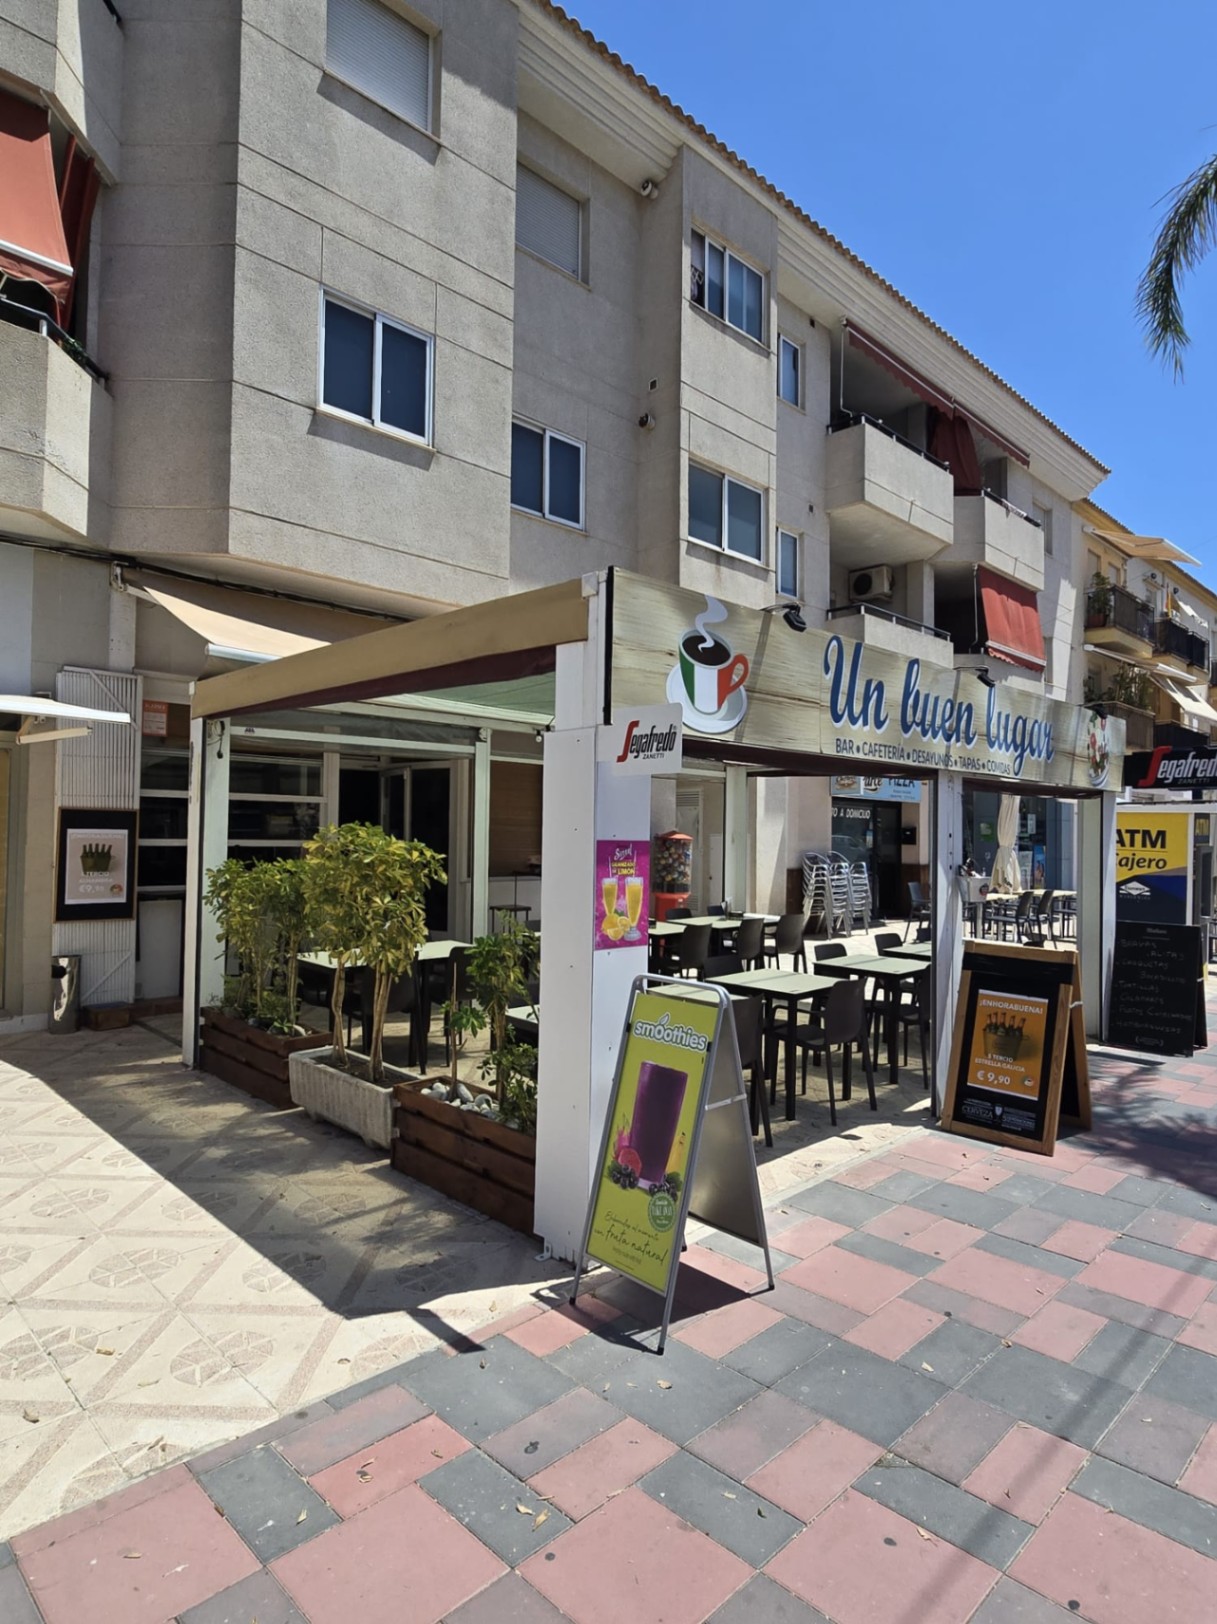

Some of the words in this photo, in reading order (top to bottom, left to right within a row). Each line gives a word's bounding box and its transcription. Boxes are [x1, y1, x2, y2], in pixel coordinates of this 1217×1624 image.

[824, 635, 889, 732] Un
[901, 658, 978, 747] buen
[985, 686, 1056, 776] lugar
[616, 719, 677, 763] Segafredo
[642, 752, 665, 760] ZANETTI
[835, 738, 855, 755] BAR
[861, 742, 905, 761] CAFETERÍA
[911, 749, 954, 768] DESAYUNOS
[958, 756, 981, 771] TAPAS
[986, 760, 1011, 775] COMIDAS
[1177, 777, 1210, 785] ZANETTI
[1116, 829, 1167, 849] ATM
[1116, 853, 1167, 871] ajero
[979, 999, 1043, 1015] ¡ENHORABUENA!
[634, 1021, 708, 1051] smoothies
[975, 1057, 1002, 1068] ESTRELLA
[1001, 1062, 1026, 1073] GALICIA
[992, 1054, 1014, 1063] TERCIO
[987, 1071, 1011, 1085] 9,90
[605, 1223, 630, 1245] fruta
[631, 1240, 669, 1266] natural
